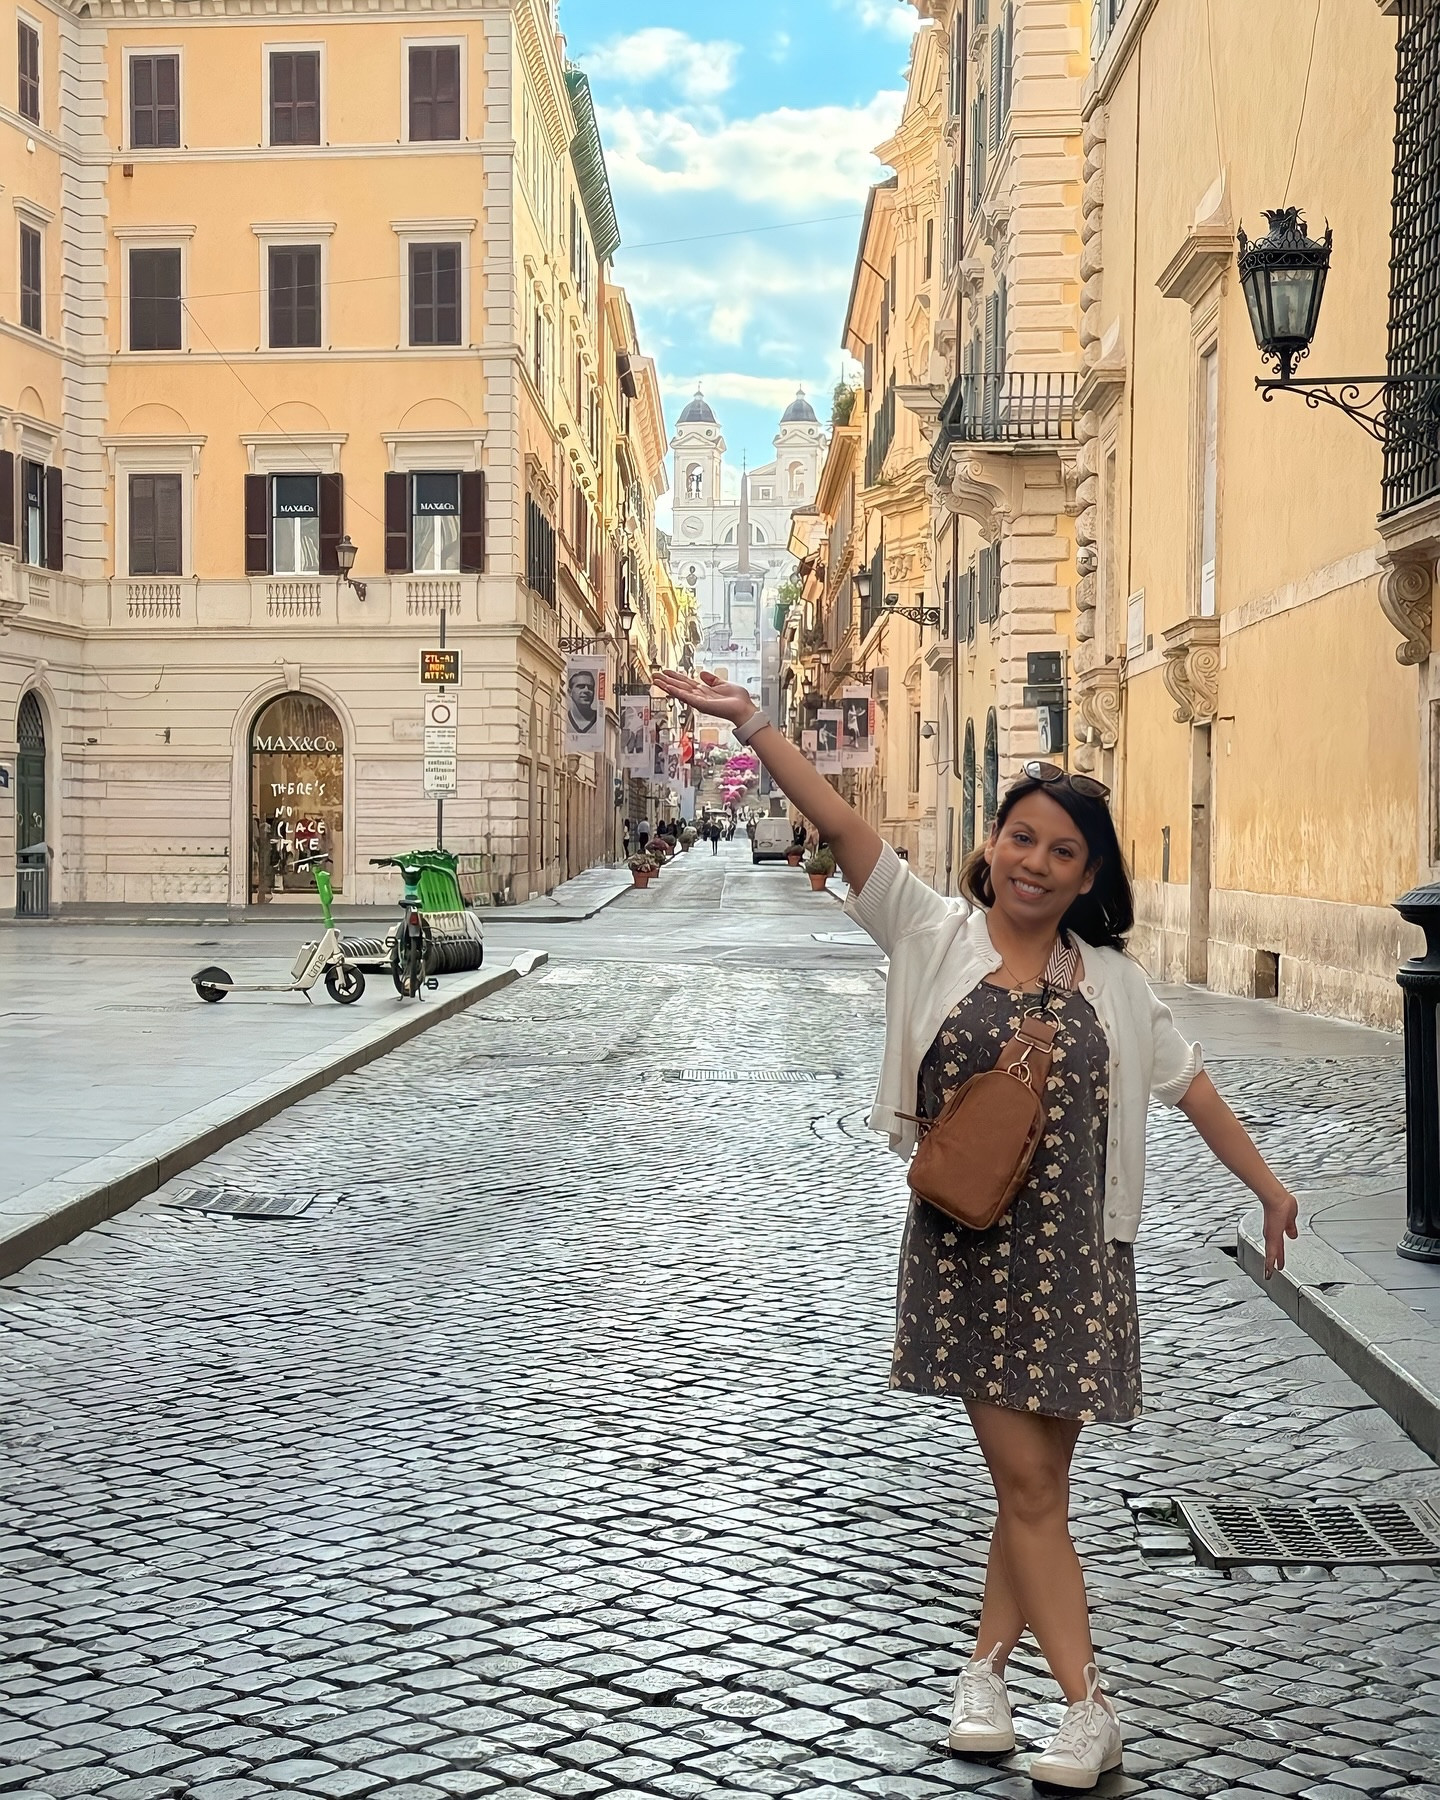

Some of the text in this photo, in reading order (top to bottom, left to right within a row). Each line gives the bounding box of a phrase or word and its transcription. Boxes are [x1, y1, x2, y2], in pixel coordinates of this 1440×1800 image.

[255, 735, 338, 752] MAX&Co.
[270, 780, 326, 797] THERE'S
[275, 805, 293, 818] NO
